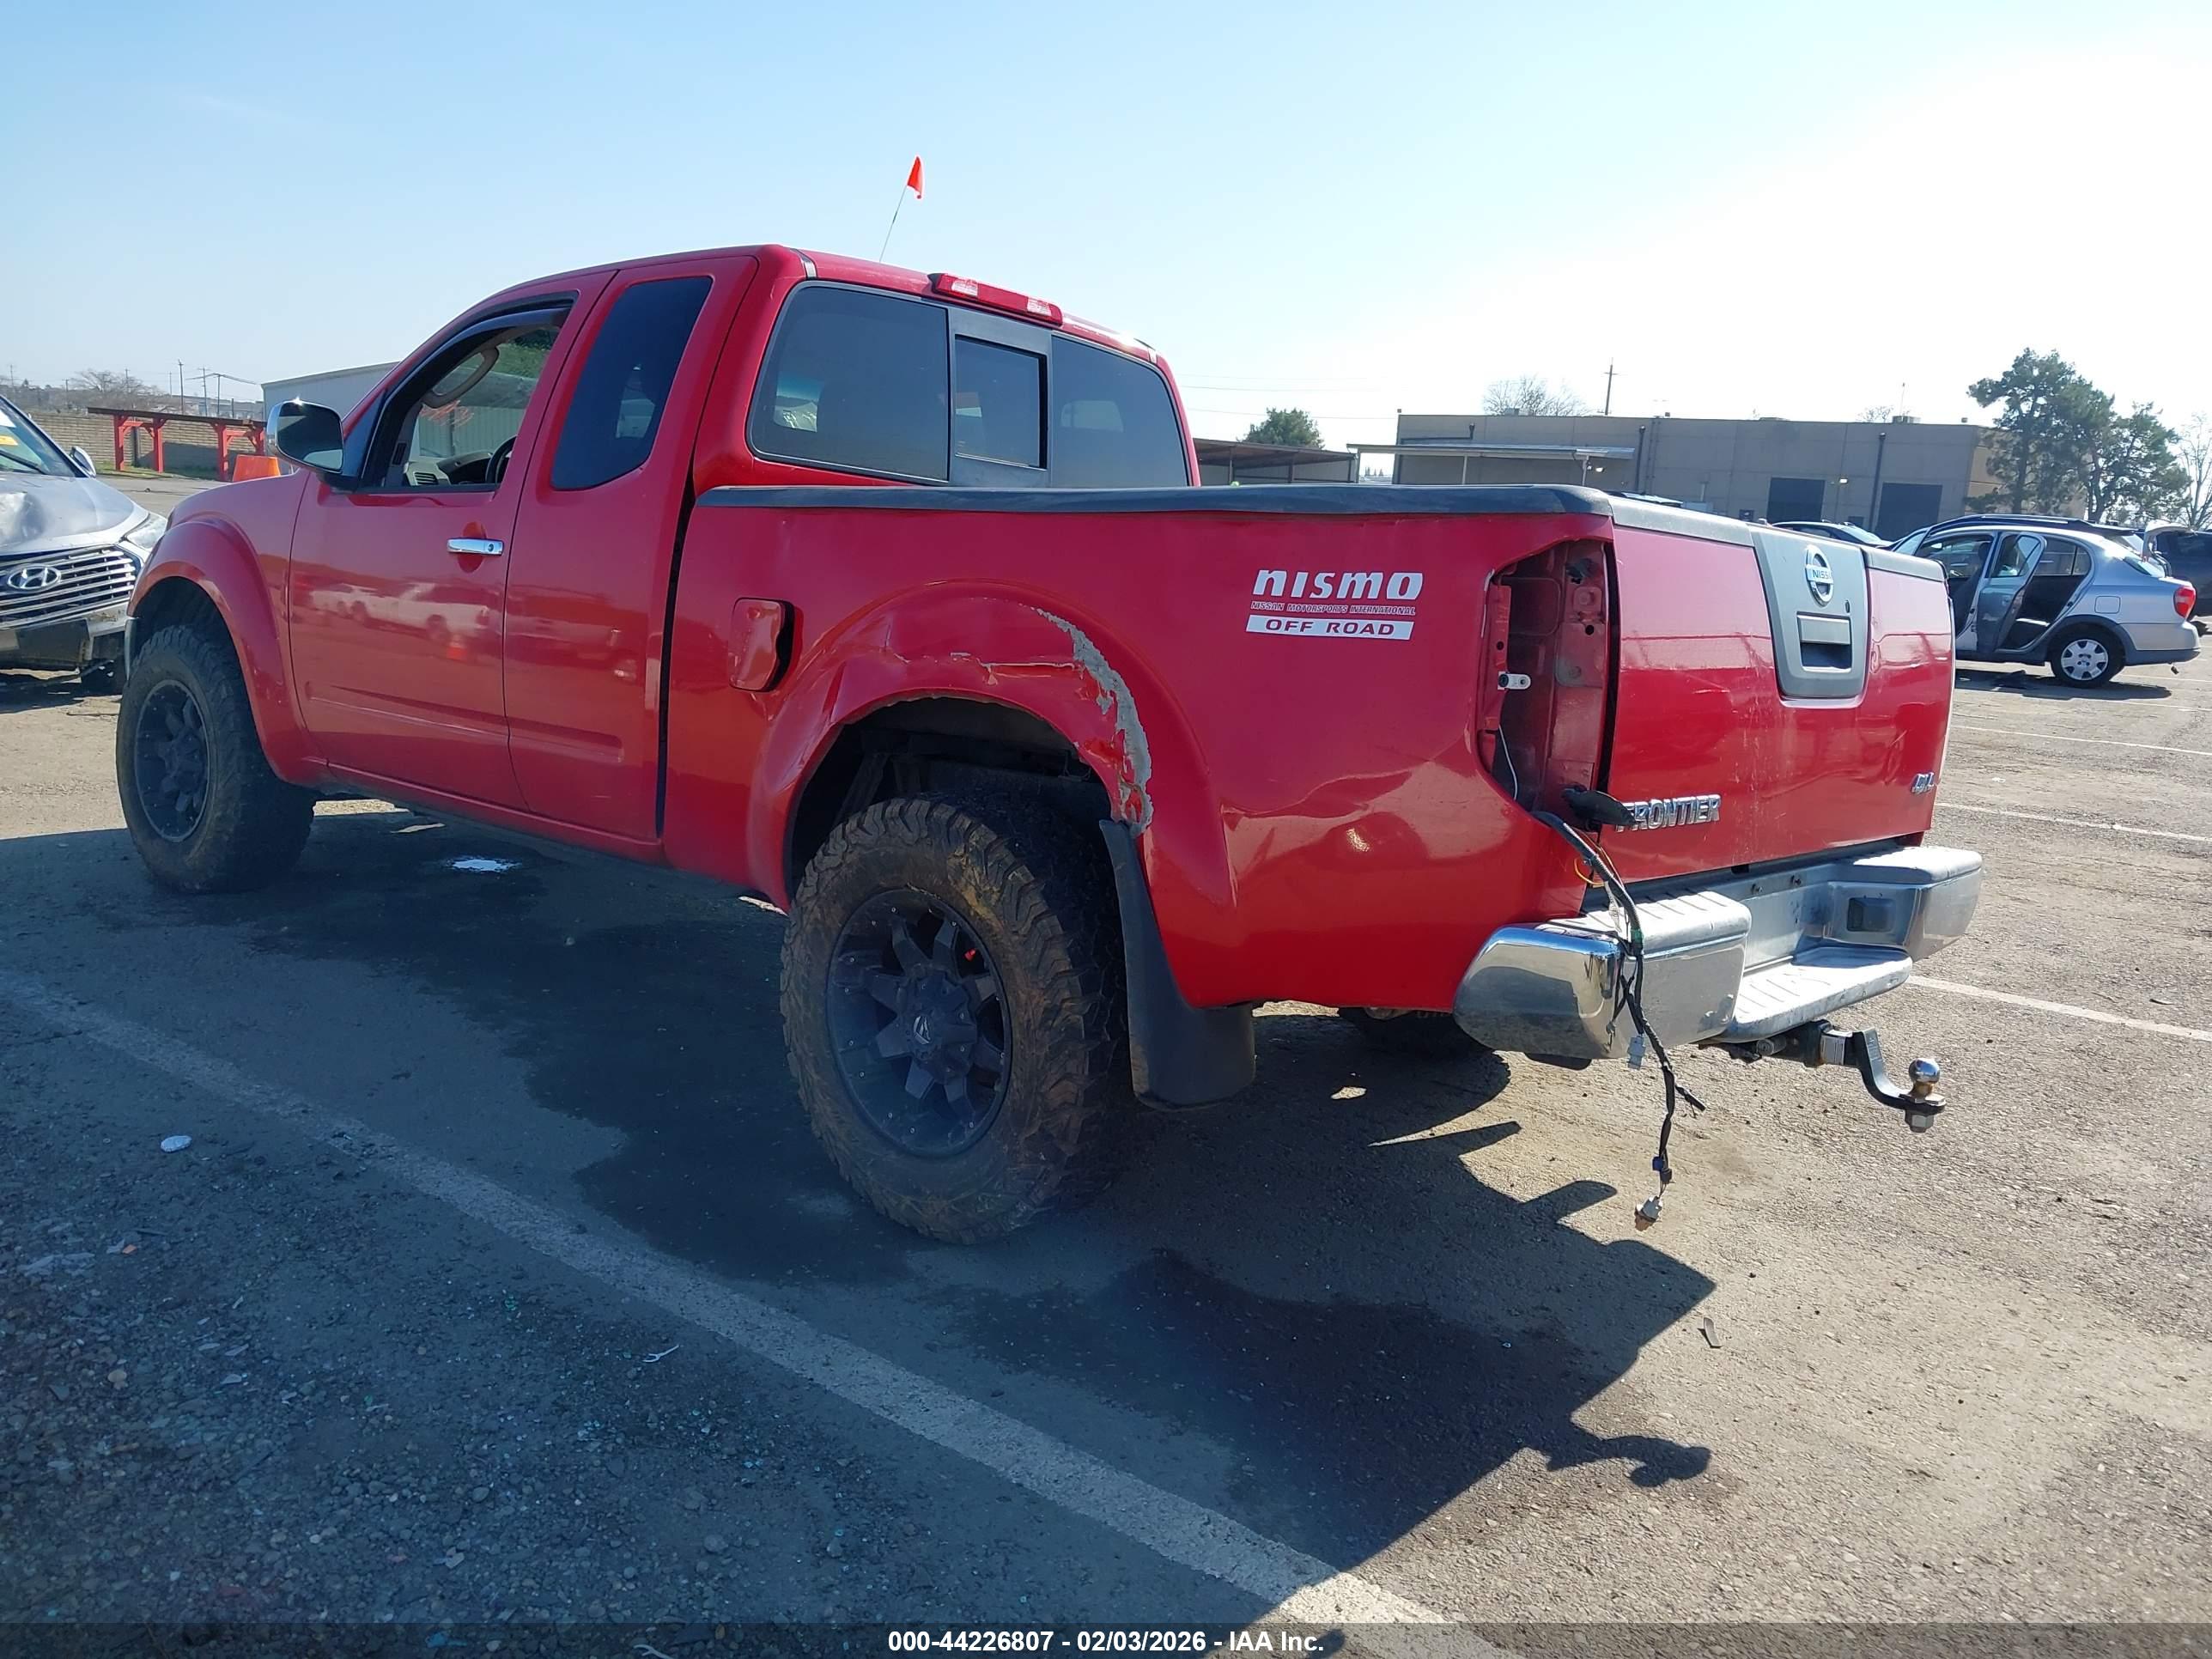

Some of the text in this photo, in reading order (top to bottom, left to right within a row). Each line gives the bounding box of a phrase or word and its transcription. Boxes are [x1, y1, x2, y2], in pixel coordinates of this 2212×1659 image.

[1252, 569, 1423, 600] nismo
[1251, 601, 1415, 615] NISSAN MOTORSPORTS INTERNATIONAL
[1266, 619, 1395, 635] OFF ROAD
